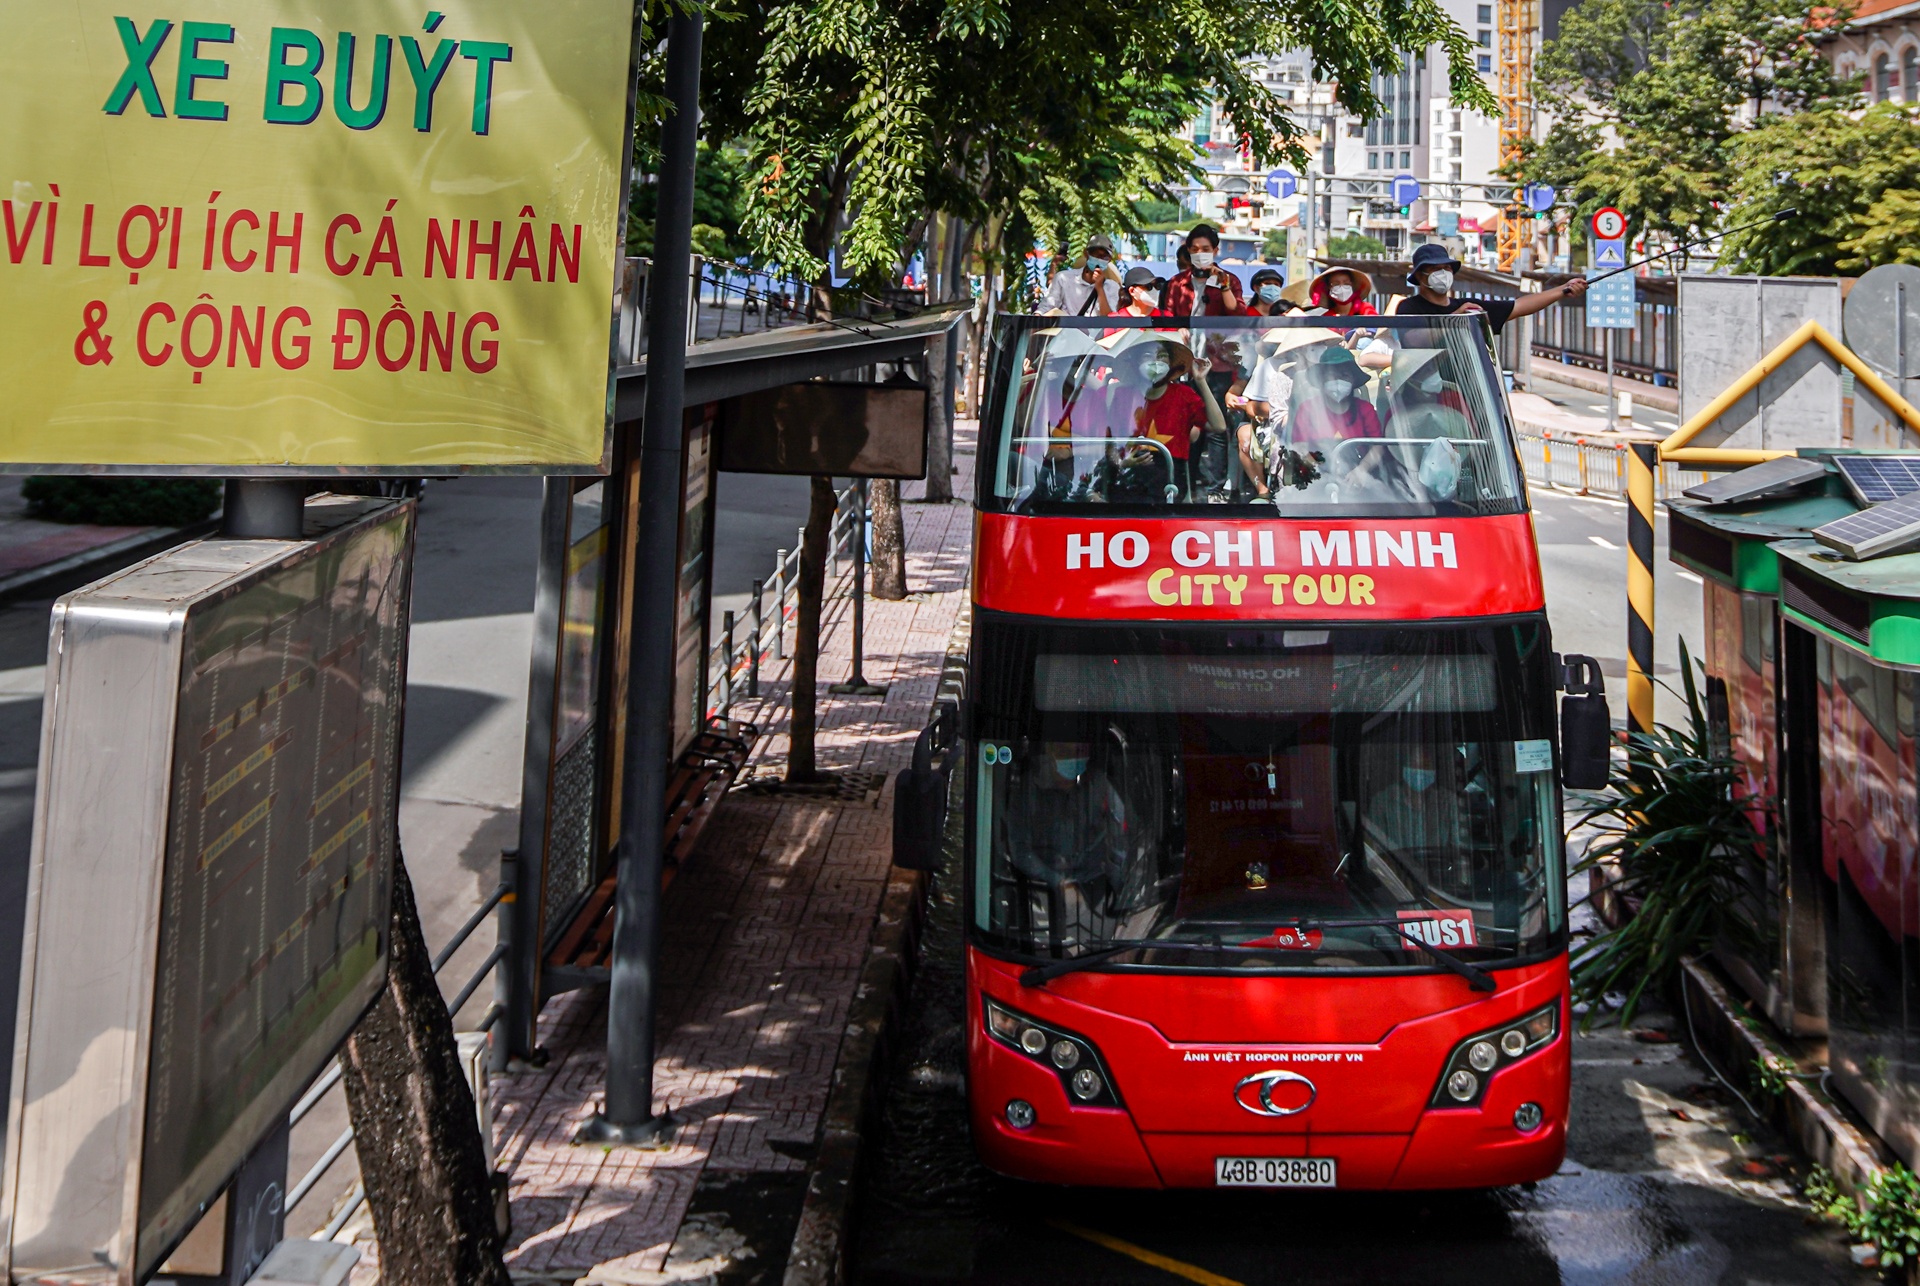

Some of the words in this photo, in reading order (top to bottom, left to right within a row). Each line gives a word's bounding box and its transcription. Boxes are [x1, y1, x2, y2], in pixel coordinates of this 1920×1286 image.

[102, 16, 236, 122] XE
[263, 11, 513, 136] BUÝT
[1, 183, 61, 266] VÌ
[78, 203, 183, 285] LỢI
[203, 190, 303, 274] ÍCH
[324, 199, 403, 278] CÁ
[424, 205, 583, 284] NHÂN
[1605, 217, 1613, 231] 5
[73, 300, 114, 368] &
[136, 293, 312, 385] CỘNG
[331, 295, 501, 374] ĐỒNG
[1066, 531, 1150, 570] HO
[1171, 530, 1275, 568] CHI
[1299, 530, 1458, 569] MINH
[1147, 567, 1248, 606] CITY
[1263, 573, 1376, 606] TOUR
[1404, 918, 1474, 946] BUS1
[1213, 1052, 1241, 1063] VIỆT
[1245, 1053, 1289, 1062] HOPON
[1292, 1053, 1342, 1062] HOPOFF
[1345, 1053, 1363, 1062] VN
